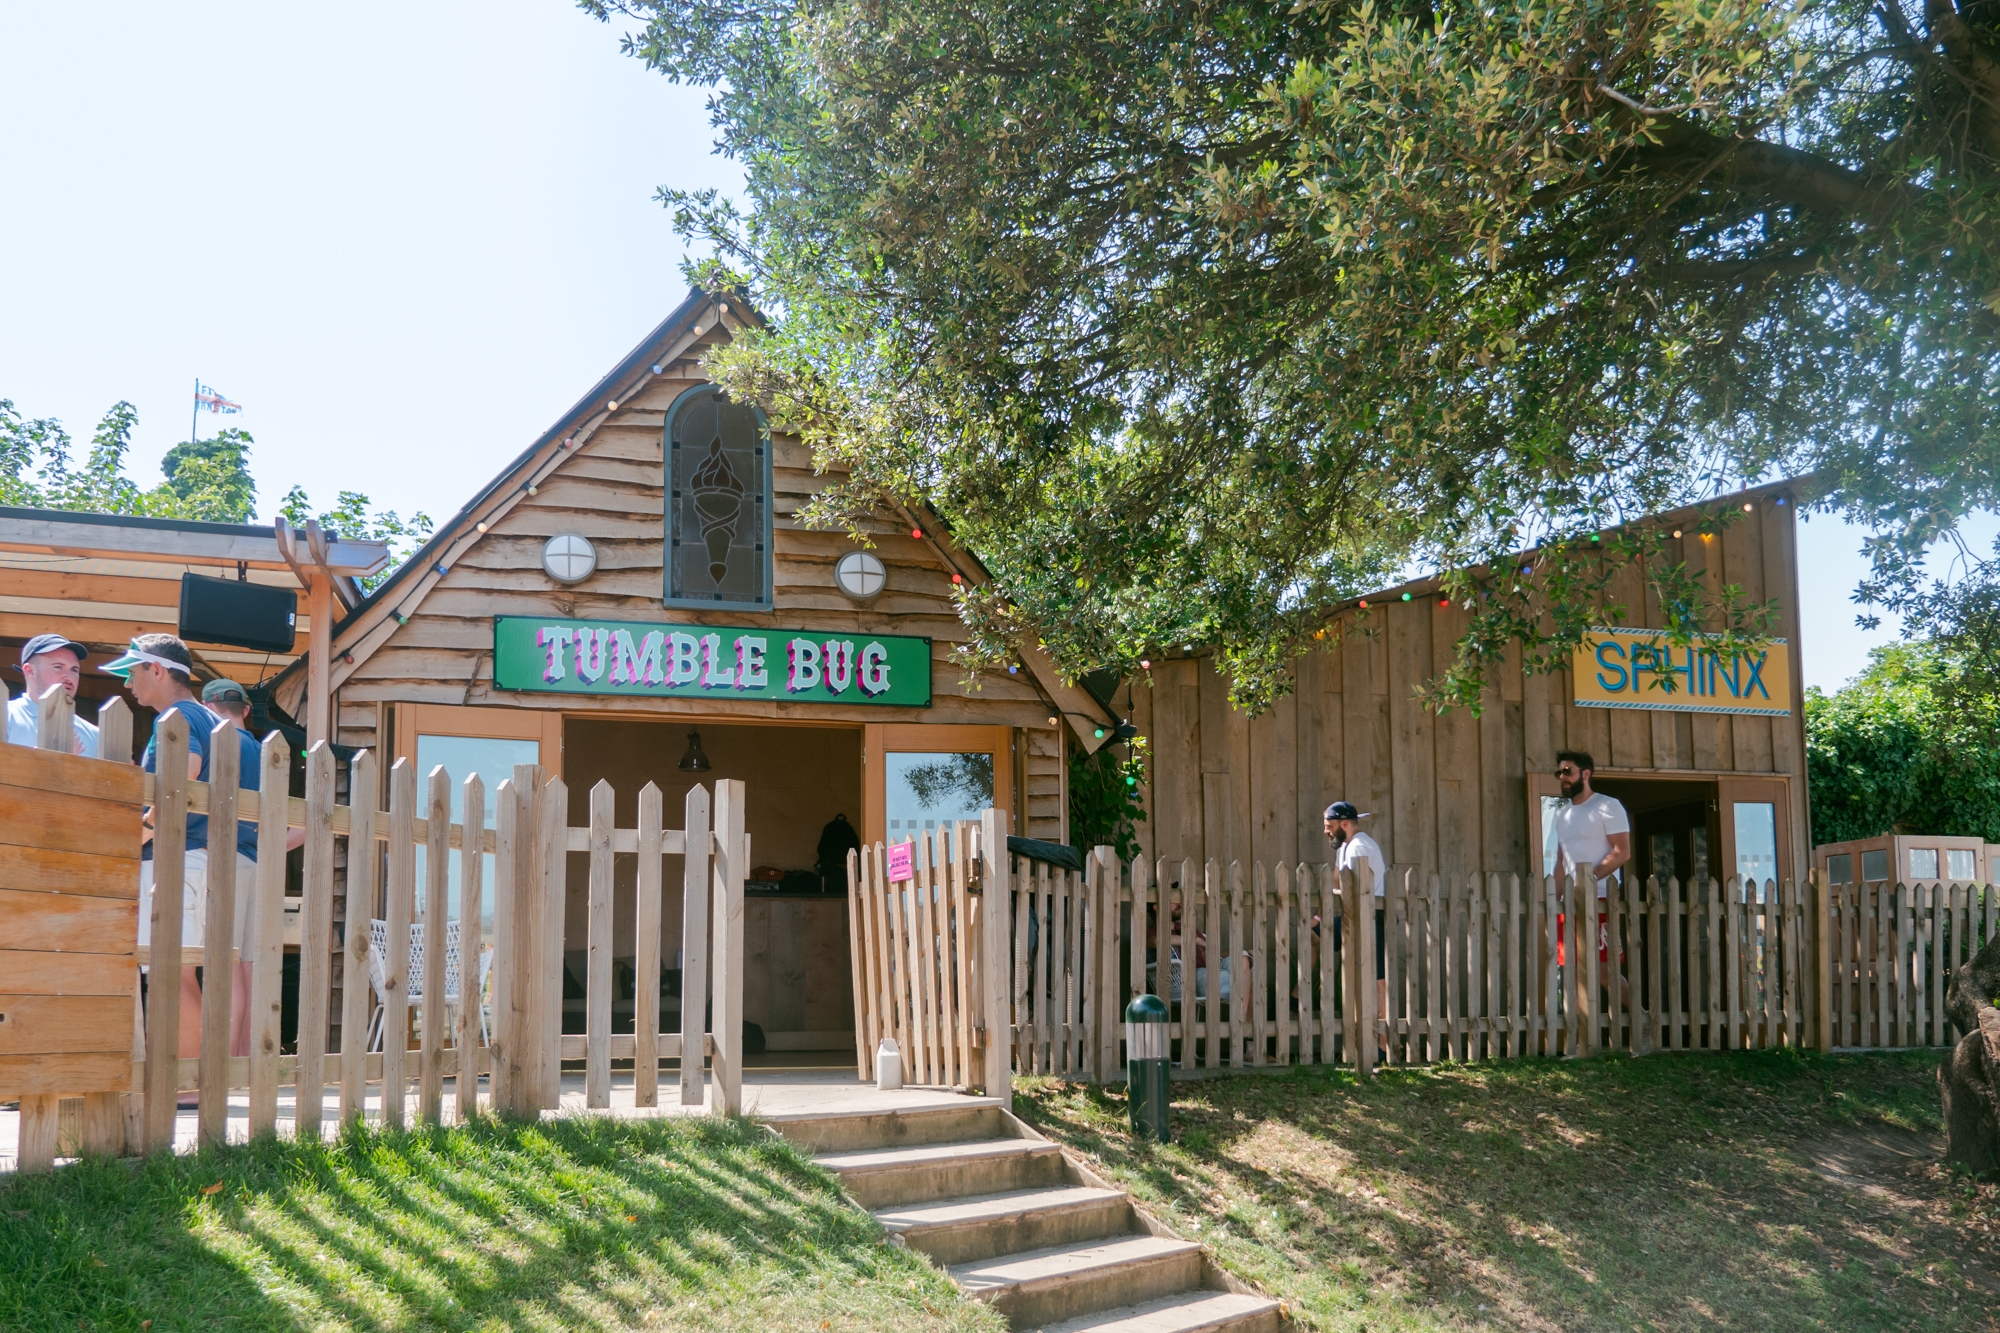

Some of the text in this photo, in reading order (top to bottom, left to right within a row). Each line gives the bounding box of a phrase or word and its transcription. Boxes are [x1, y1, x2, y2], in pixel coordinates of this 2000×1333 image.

[536, 625, 891, 699] TUMBLE BUG
[1595, 640, 1771, 700] SPHINX
